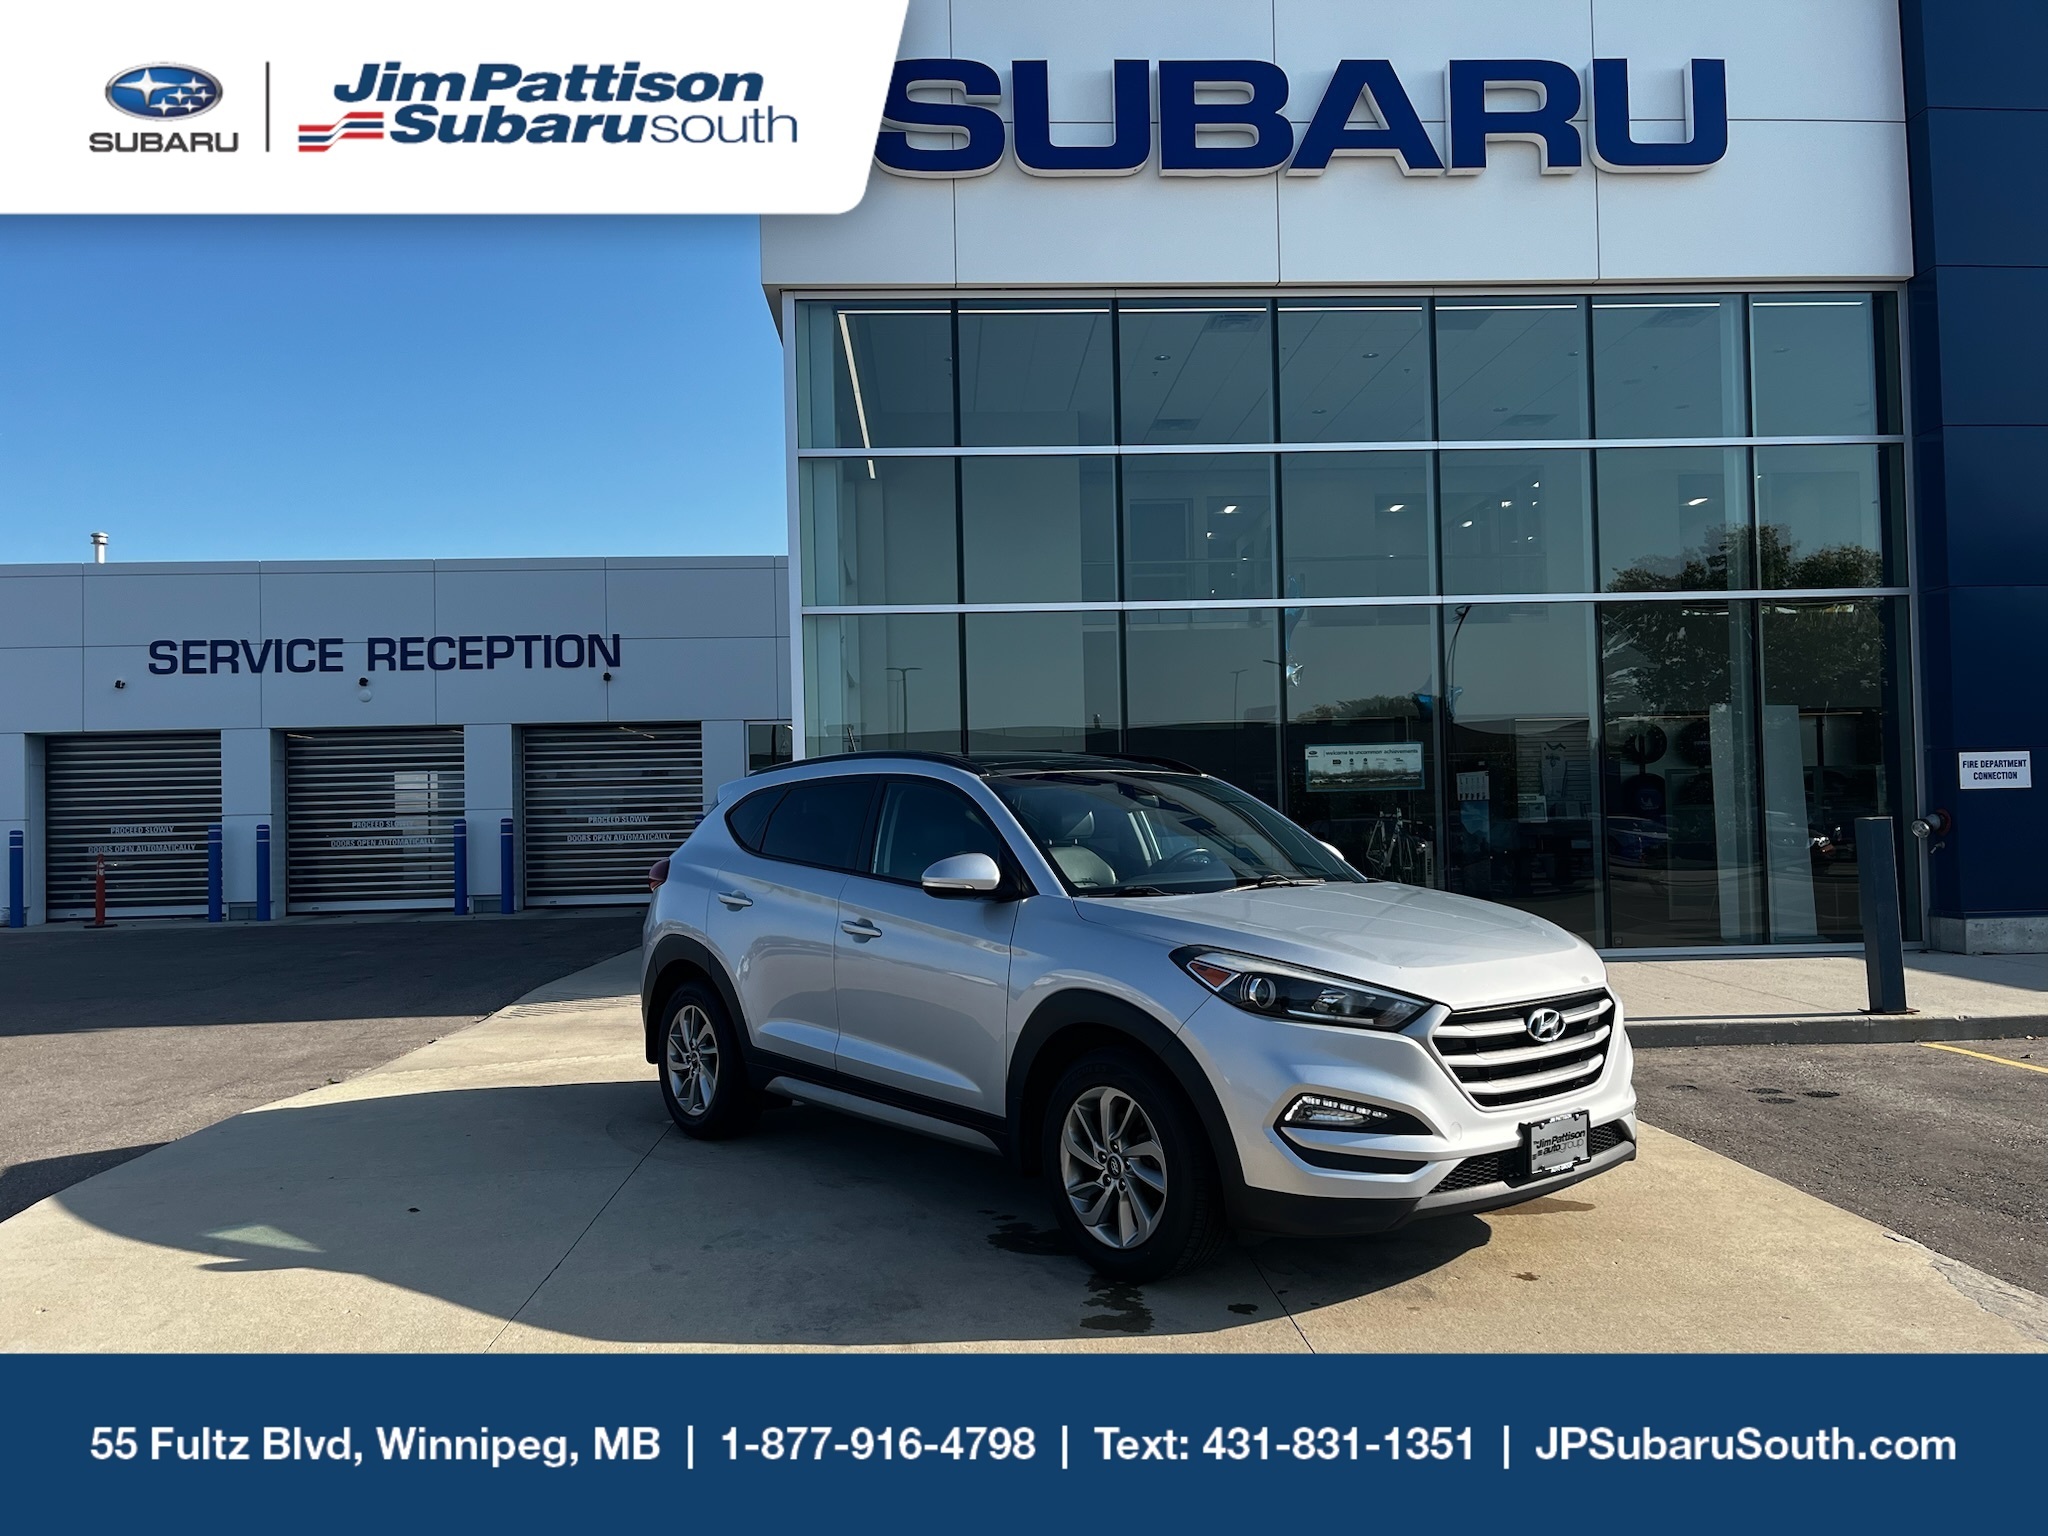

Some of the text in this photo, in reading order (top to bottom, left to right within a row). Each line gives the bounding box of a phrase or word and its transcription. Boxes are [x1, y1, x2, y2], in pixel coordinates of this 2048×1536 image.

[877, 58, 1728, 174] SUBARU
[148, 633, 621, 675] SERVICE RECEPTION
[1962, 759, 2027, 769] FIRE DEPARTMENT
[1973, 771, 2018, 780] CONNECTION
[588, 815, 650, 824] PROCEED SLOWLY
[110, 825, 175, 835] PROCEED SLOWLY
[352, 821, 384, 829] PROCEED
[566, 832, 671, 842] DOORS OPEN AUTOMATICALLY
[330, 837, 437, 848] DOORS OPEN AUTOMATICALLY
[88, 843, 197, 854] DOORS OPEN AUTOMATICALLY
